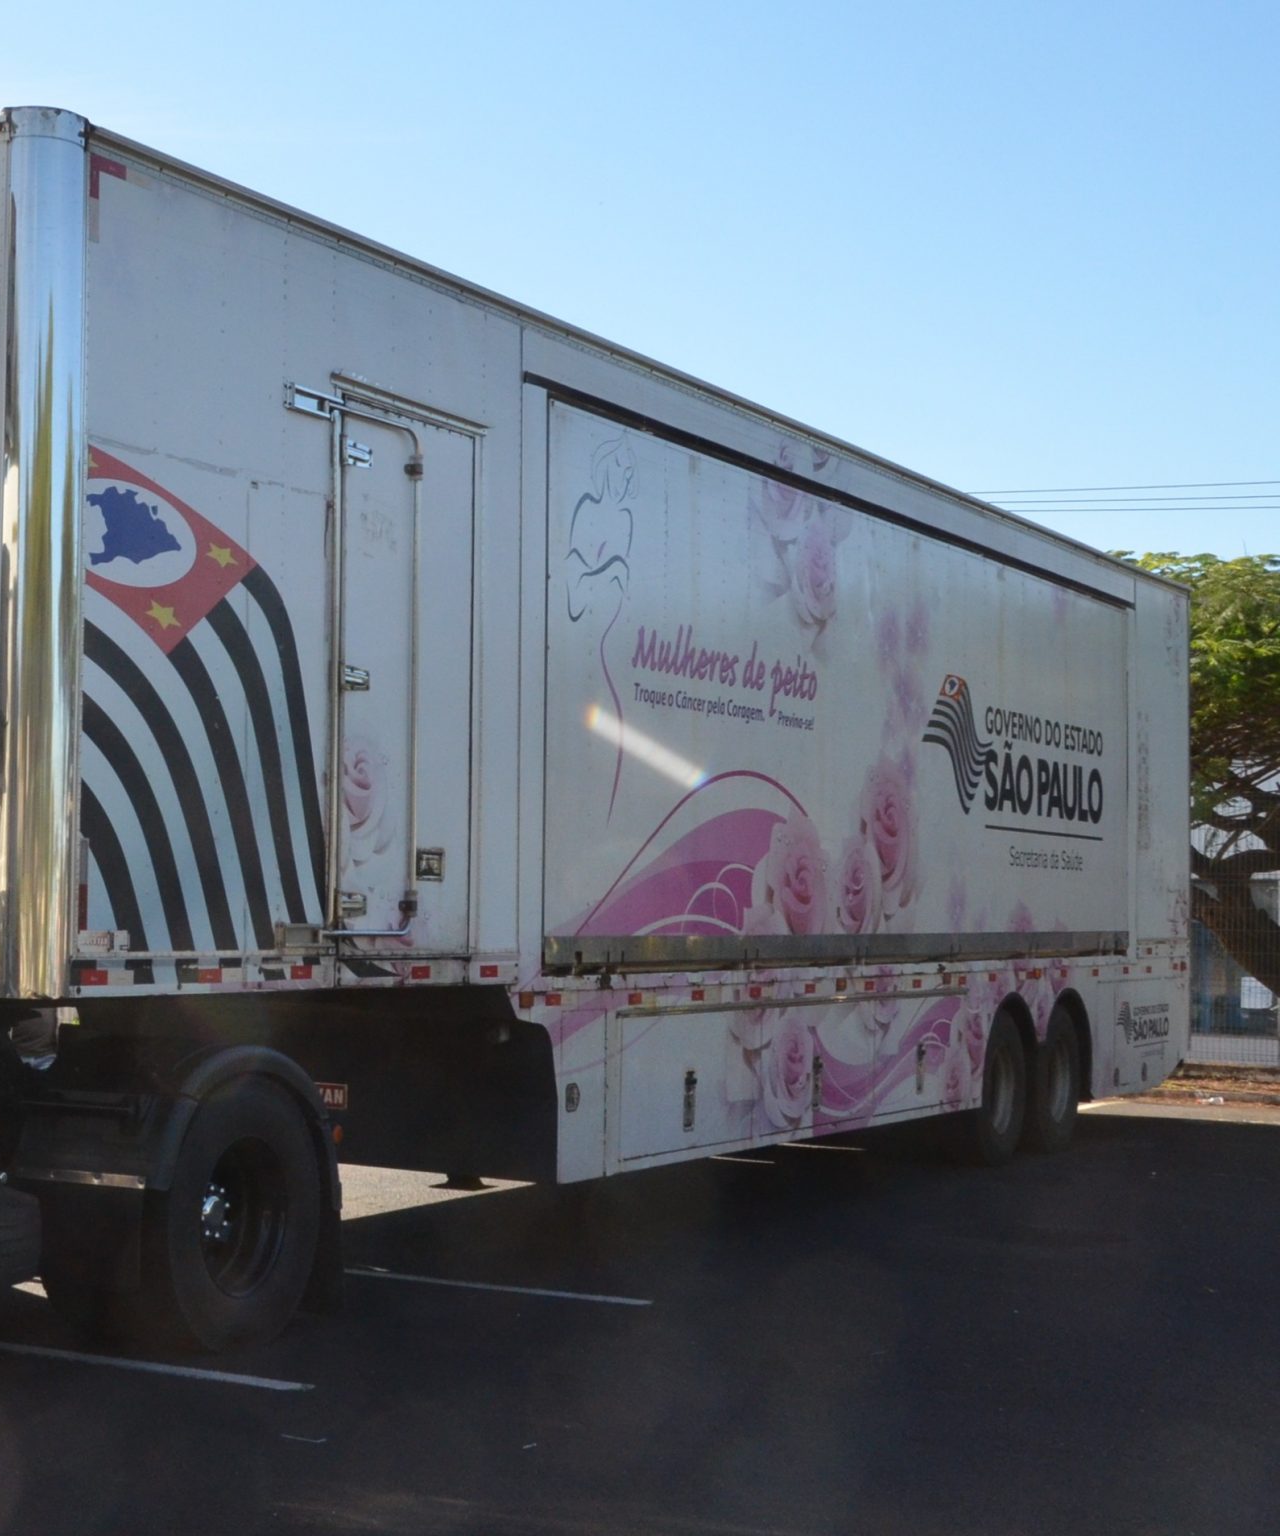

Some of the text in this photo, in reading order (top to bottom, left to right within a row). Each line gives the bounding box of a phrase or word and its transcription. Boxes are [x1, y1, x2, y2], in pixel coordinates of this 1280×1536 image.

[631, 625, 819, 718] Mulheres de peito
[633, 682, 668, 710] Troque
[667, 693, 675, 708] o
[675, 690, 707, 713] Câncer
[707, 696, 726, 719] pela
[726, 699, 767, 725] Coragem.
[985, 706, 1104, 758] GOVERNO DO ESTADO
[984, 740, 1104, 825] SÃO PAULO
[1008, 845, 1048, 870] Secretaria
[1050, 850, 1059, 870] da
